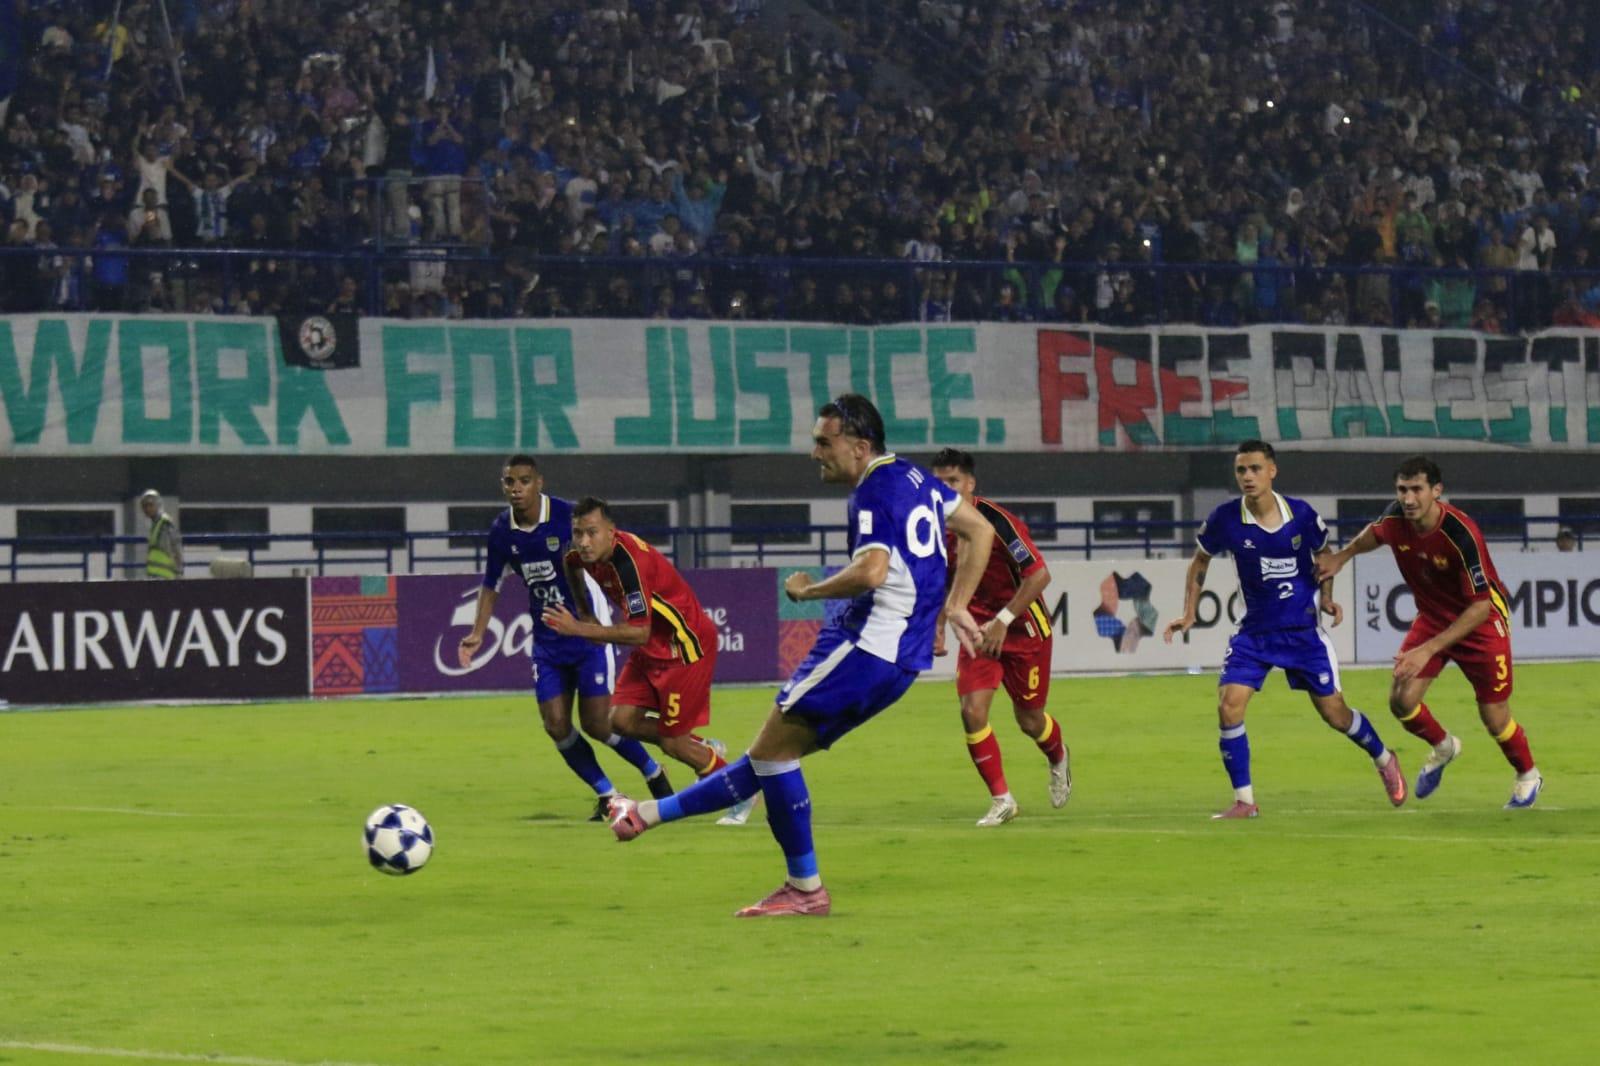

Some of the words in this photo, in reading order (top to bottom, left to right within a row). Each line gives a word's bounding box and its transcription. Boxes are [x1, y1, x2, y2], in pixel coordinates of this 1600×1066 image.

[0, 319, 351, 445] WORK
[382, 325, 581, 449] FOR
[614, 326, 1006, 448] JUSTICE.
[1037, 329, 1261, 446] FREE
[1278, 581, 1296, 599] 2
[1367, 584, 1380, 632] AFC
[2, 606, 287, 672] AIRWAYS
[1028, 666, 1040, 690] 6
[1495, 654, 1508, 681] 3
[667, 693, 681, 717] 5
